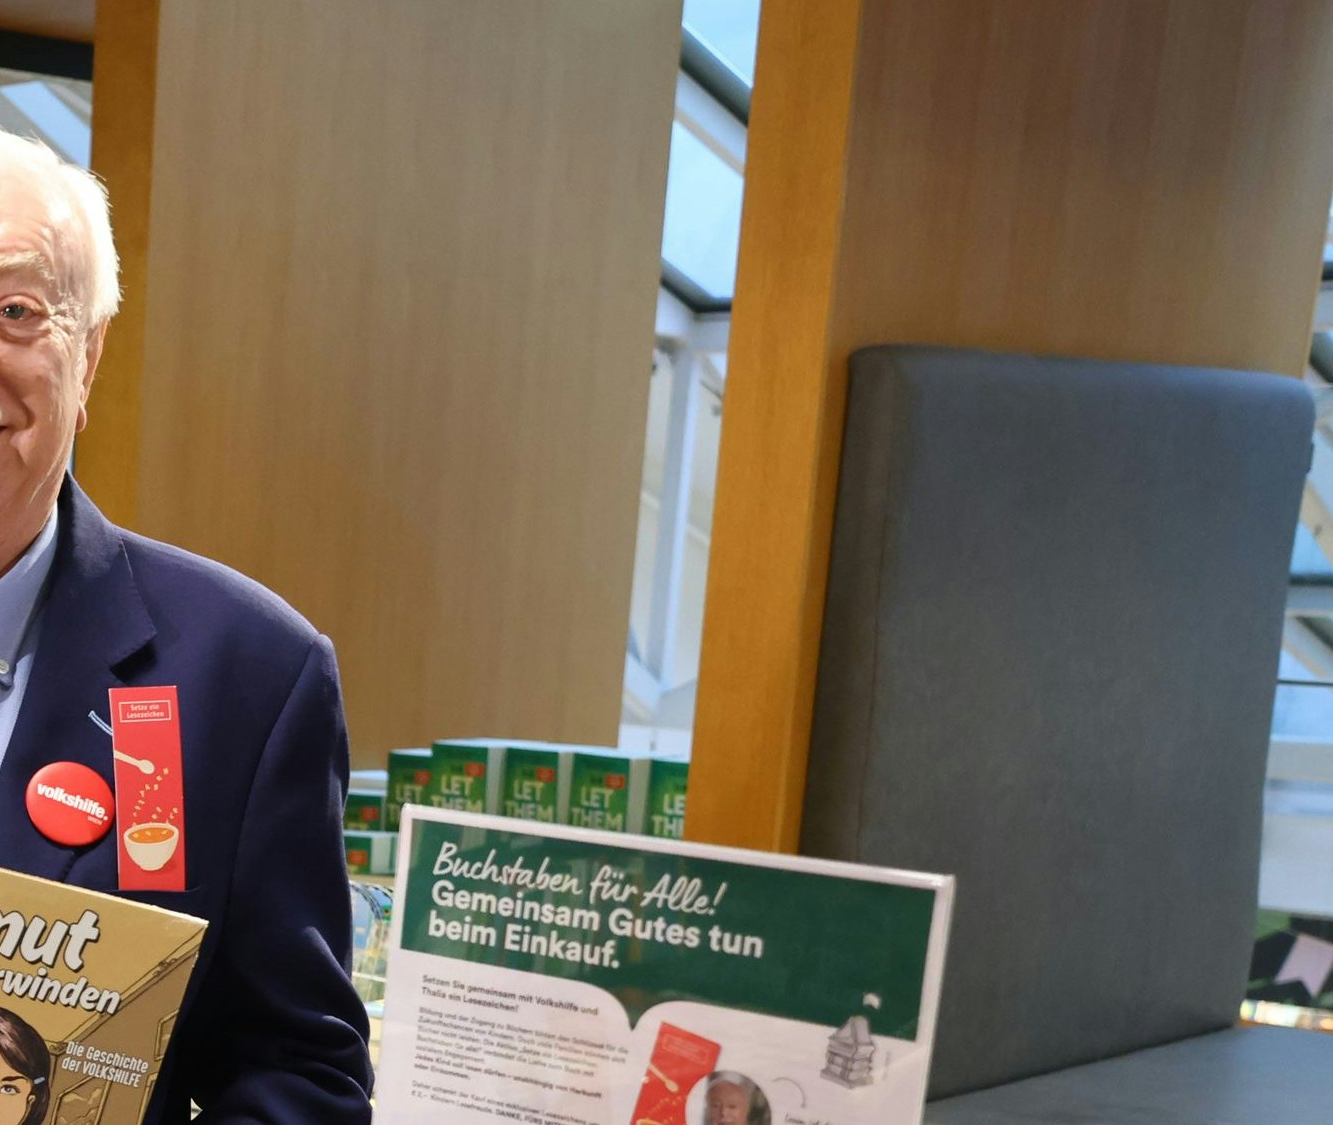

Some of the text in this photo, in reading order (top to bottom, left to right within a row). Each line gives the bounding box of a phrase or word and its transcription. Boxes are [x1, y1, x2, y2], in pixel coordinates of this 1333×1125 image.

[440, 774, 473, 796] LET
[514, 781, 543, 801] LET
[580, 786, 614, 808] LET
[37, 783, 108, 820] volkshilfe.
[434, 842, 727, 917] Buchstaben für Alle!
[433, 880, 764, 959] Gemeinsam Gutes tun
[428, 912, 620, 969] beim Einkauf.
[422, 987, 446, 999] Thalia
[423, 975, 450, 987] Setzen
[453, 980, 465, 990] Sie
[468, 982, 516, 1001] gemeinsam
[519, 992, 533, 1003] mit
[535, 996, 578, 1012] Volkshilfe
[62, 1057, 141, 1088] der VOLKSHILFE
[65, 1041, 149, 1073] Die Geschichte
